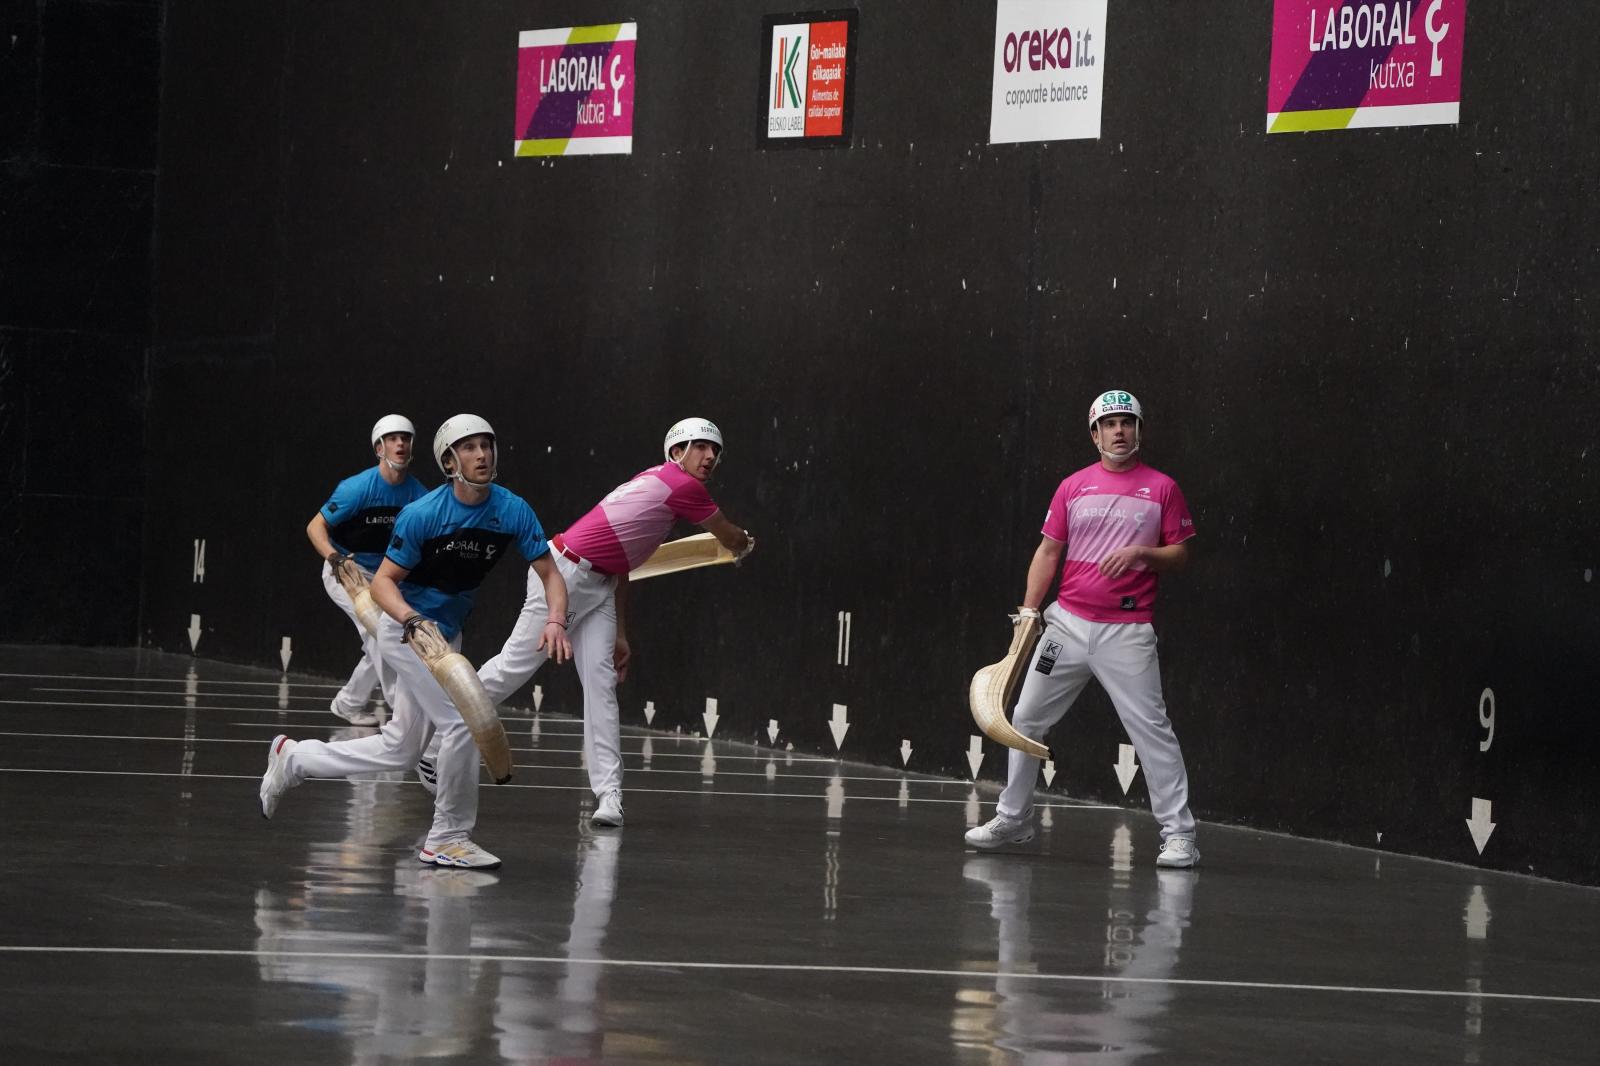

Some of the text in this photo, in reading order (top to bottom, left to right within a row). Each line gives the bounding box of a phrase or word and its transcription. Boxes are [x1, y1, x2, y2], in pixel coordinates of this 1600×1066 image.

[1309, 1, 1416, 52] LABORAL
[810, 43, 846, 60] Goi-mailako
[540, 55, 605, 93] LABORAL
[812, 64, 842, 85] elikagaiak
[1369, 57, 1415, 90] kutxa
[811, 89, 839, 101] Alimentos de
[1005, 81, 1088, 109] corporate balance
[576, 99, 605, 125] kutxa
[769, 115, 803, 132] EUSKO LABEL
[365, 516, 395, 524] LABOR
[193, 539, 206, 583] 14
[837, 610, 852, 667] 11
[1479, 687, 1495, 752] 9
